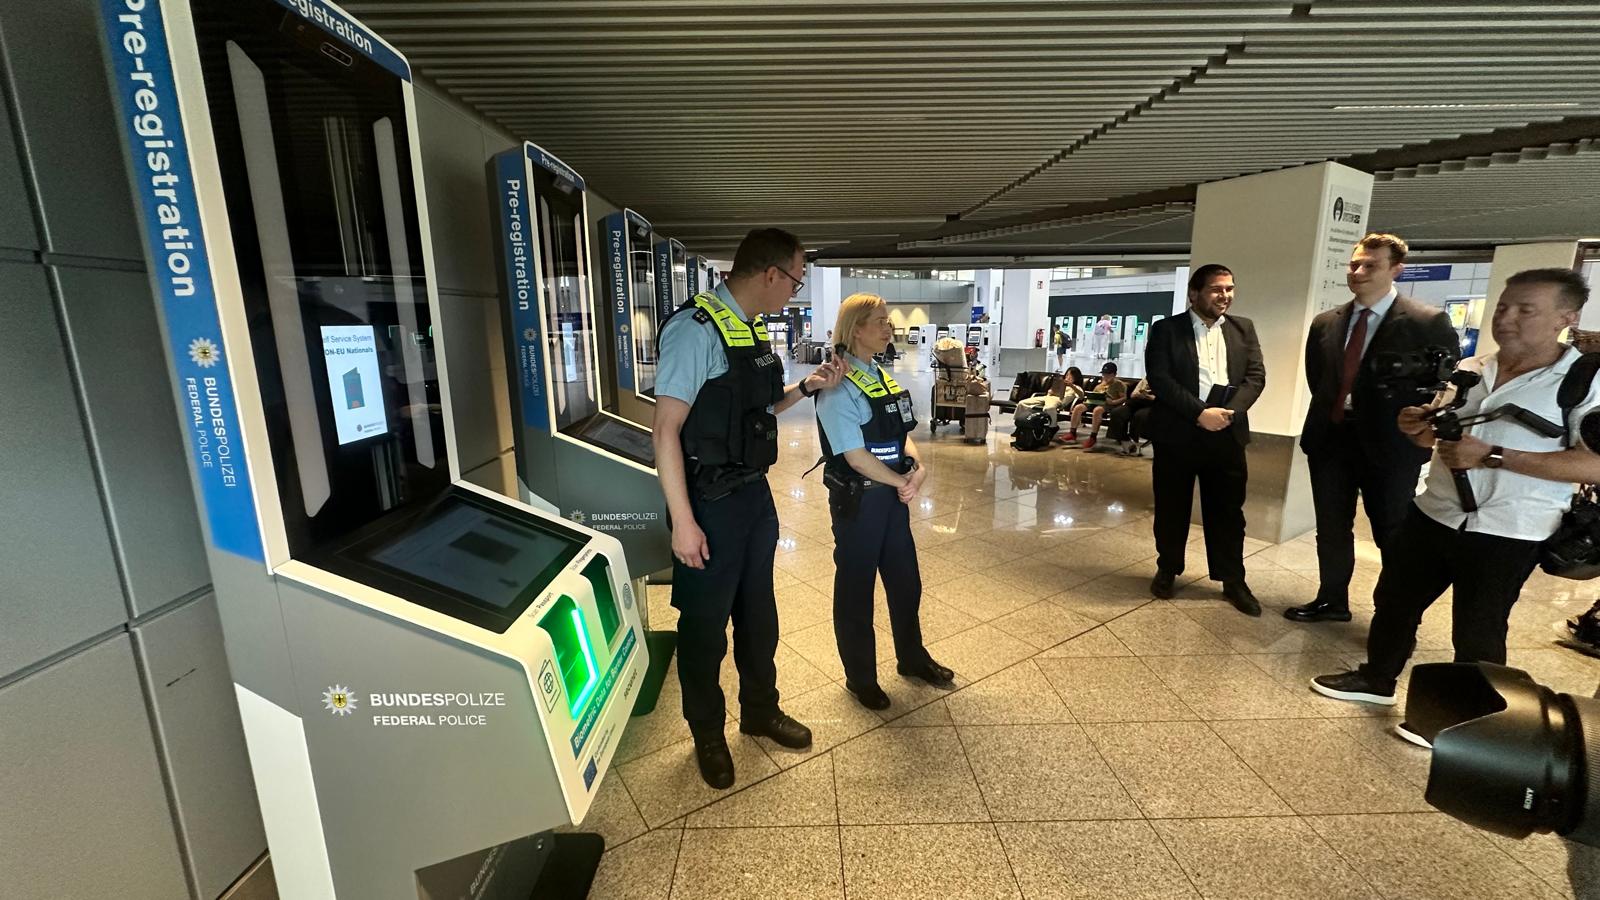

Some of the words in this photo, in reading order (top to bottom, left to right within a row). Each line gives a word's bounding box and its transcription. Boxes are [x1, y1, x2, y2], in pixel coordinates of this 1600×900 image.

[506, 179, 529, 311] Pre-registration
[612, 230, 625, 313] Pre-registration
[660, 253, 670, 315] Pre-registration
[346, 346, 374, 354] Nationals
[528, 345, 539, 397] BUNDESPOLIZEI
[185, 377, 201, 429] FEDERAL
[197, 429, 213, 469] POLICE
[203, 377, 236, 488] BUNDESPOLIZEI
[591, 512, 658, 521] BUNDESPOLIZEI
[623, 523, 646, 531] POLICE
[373, 715, 436, 726] FEDERAL
[439, 714, 487, 726] POLICE
[573, 704, 597, 748] Biometric
